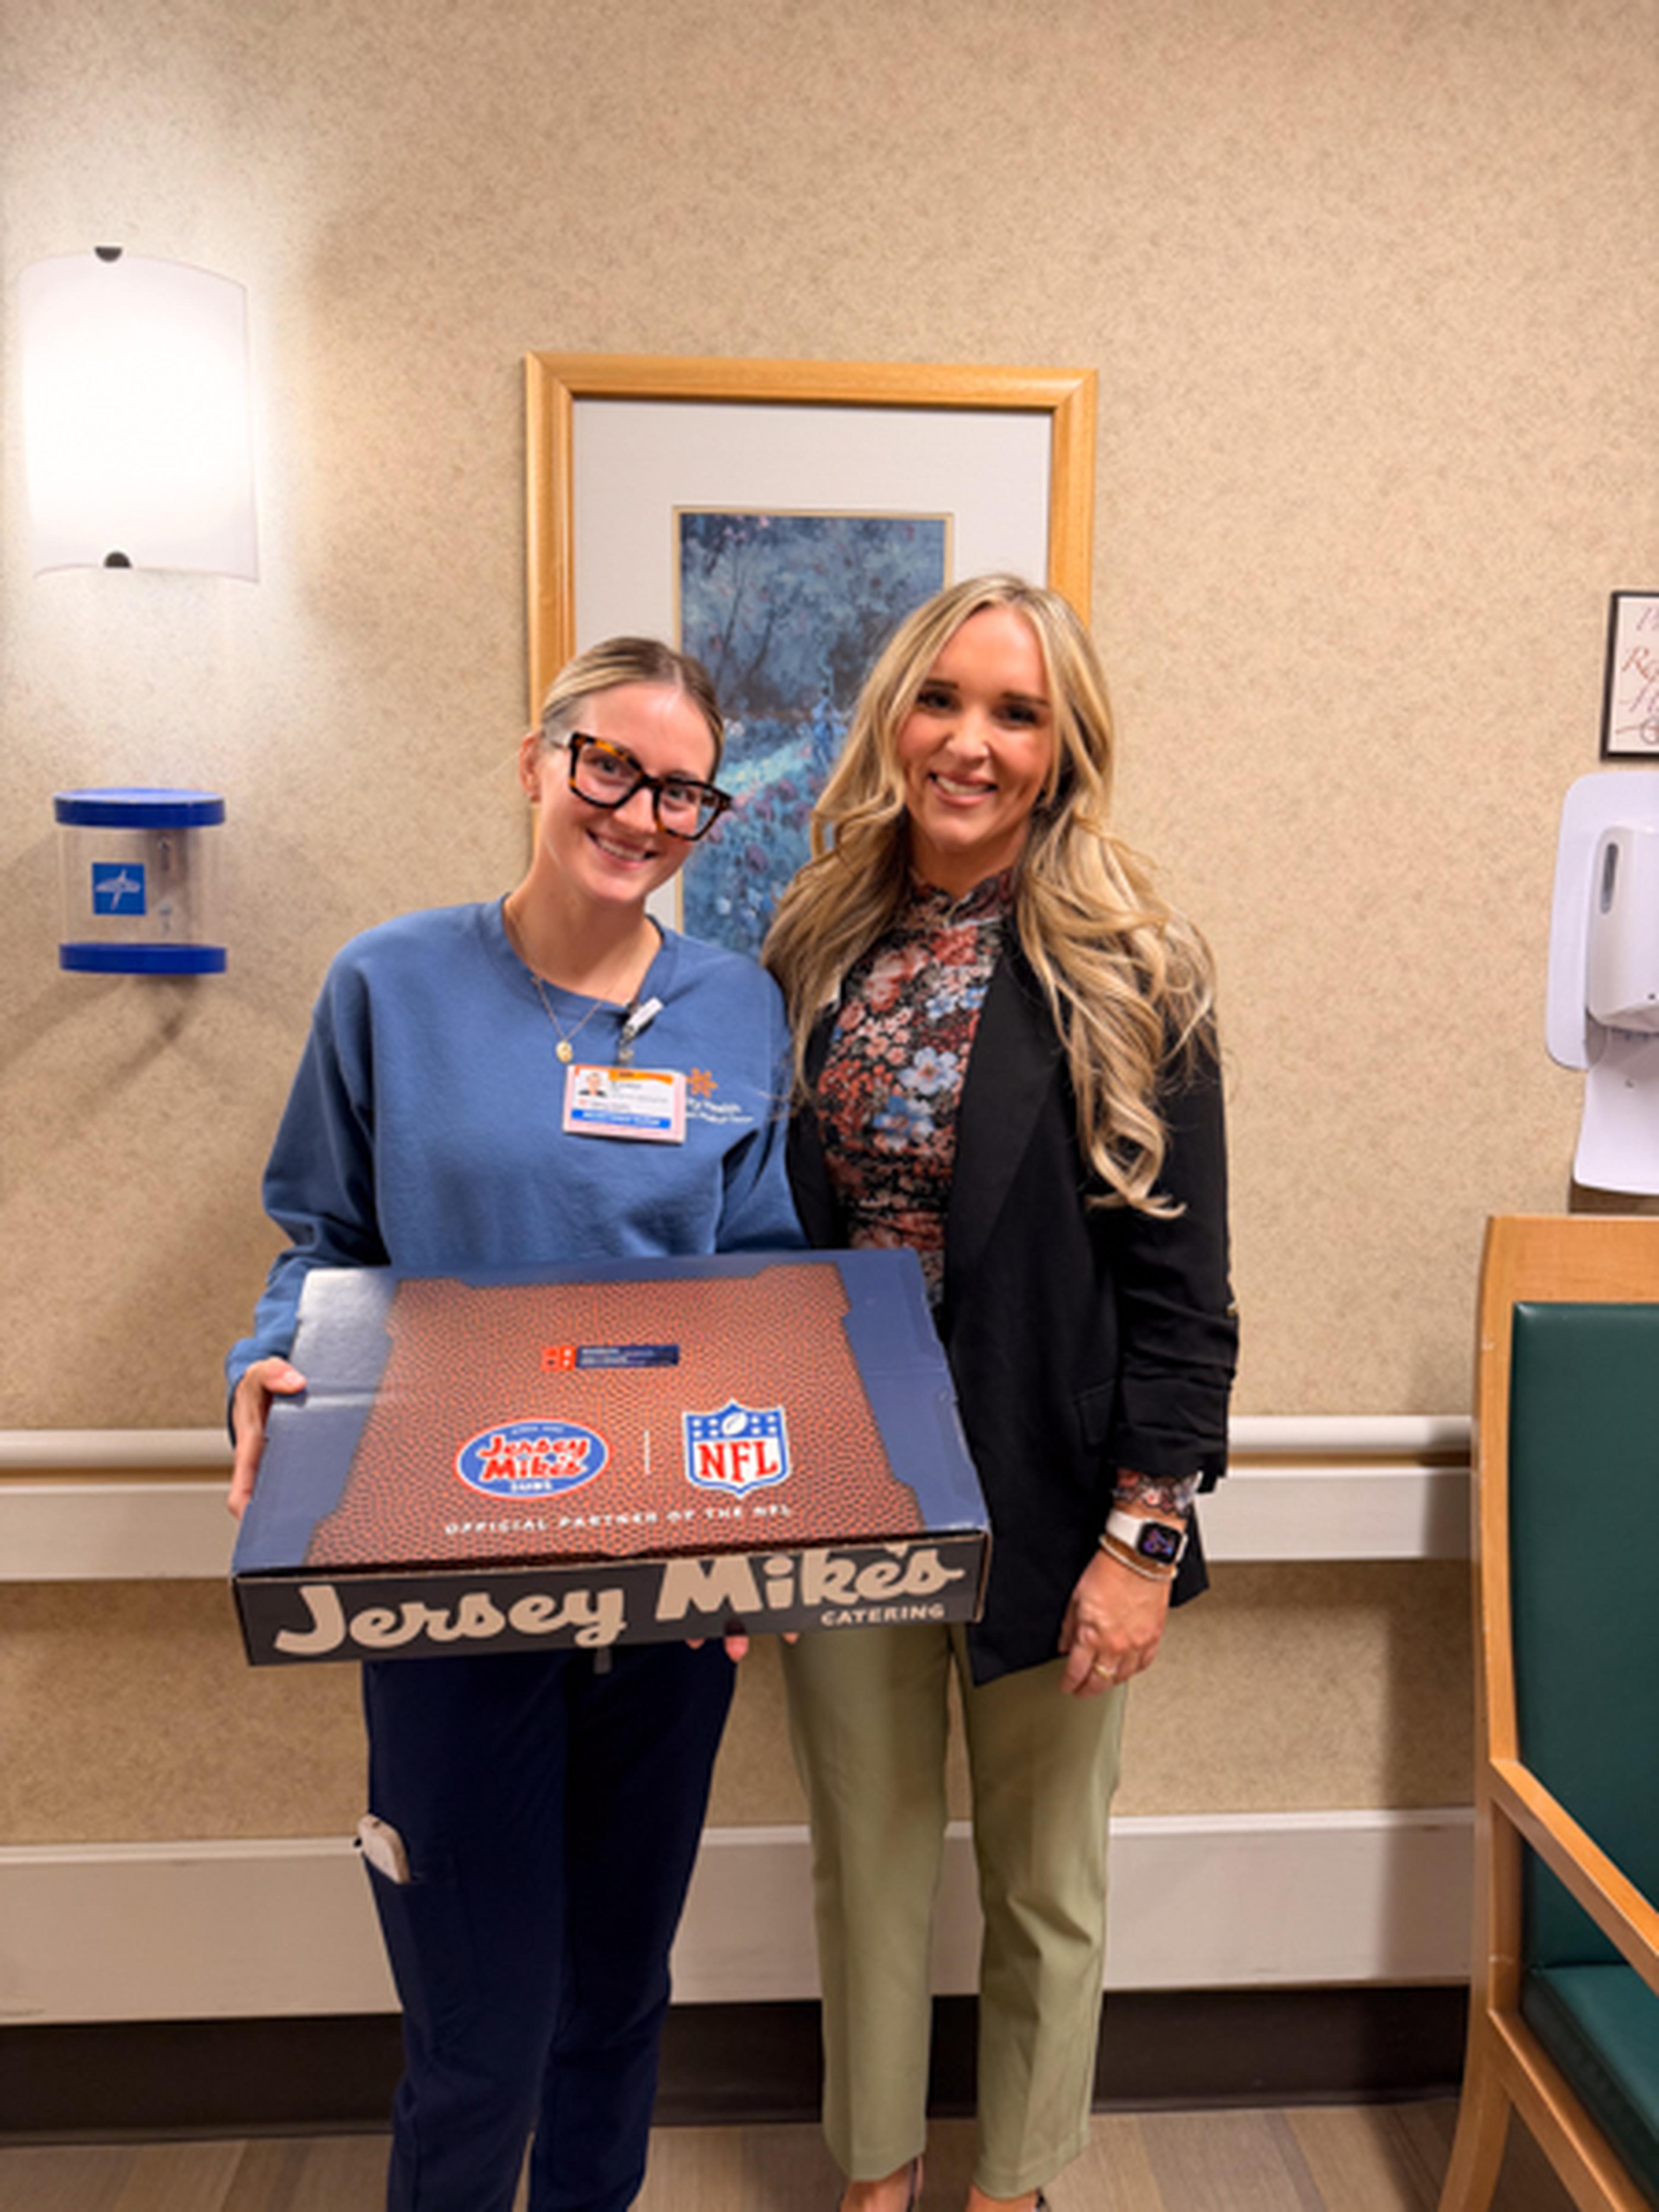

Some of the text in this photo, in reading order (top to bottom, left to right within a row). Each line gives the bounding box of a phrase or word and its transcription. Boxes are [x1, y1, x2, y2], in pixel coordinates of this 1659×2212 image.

[477, 1434, 590, 1459] Jersey
[480, 1454, 587, 1481] Mike's
[697, 1440, 779, 1483] NFL
[444, 1503, 791, 1535] OFFICIAL PARTNER OF THE NFL
[274, 1543, 965, 1656] Jersey Mike's
[821, 1603, 945, 1627] CATERING
